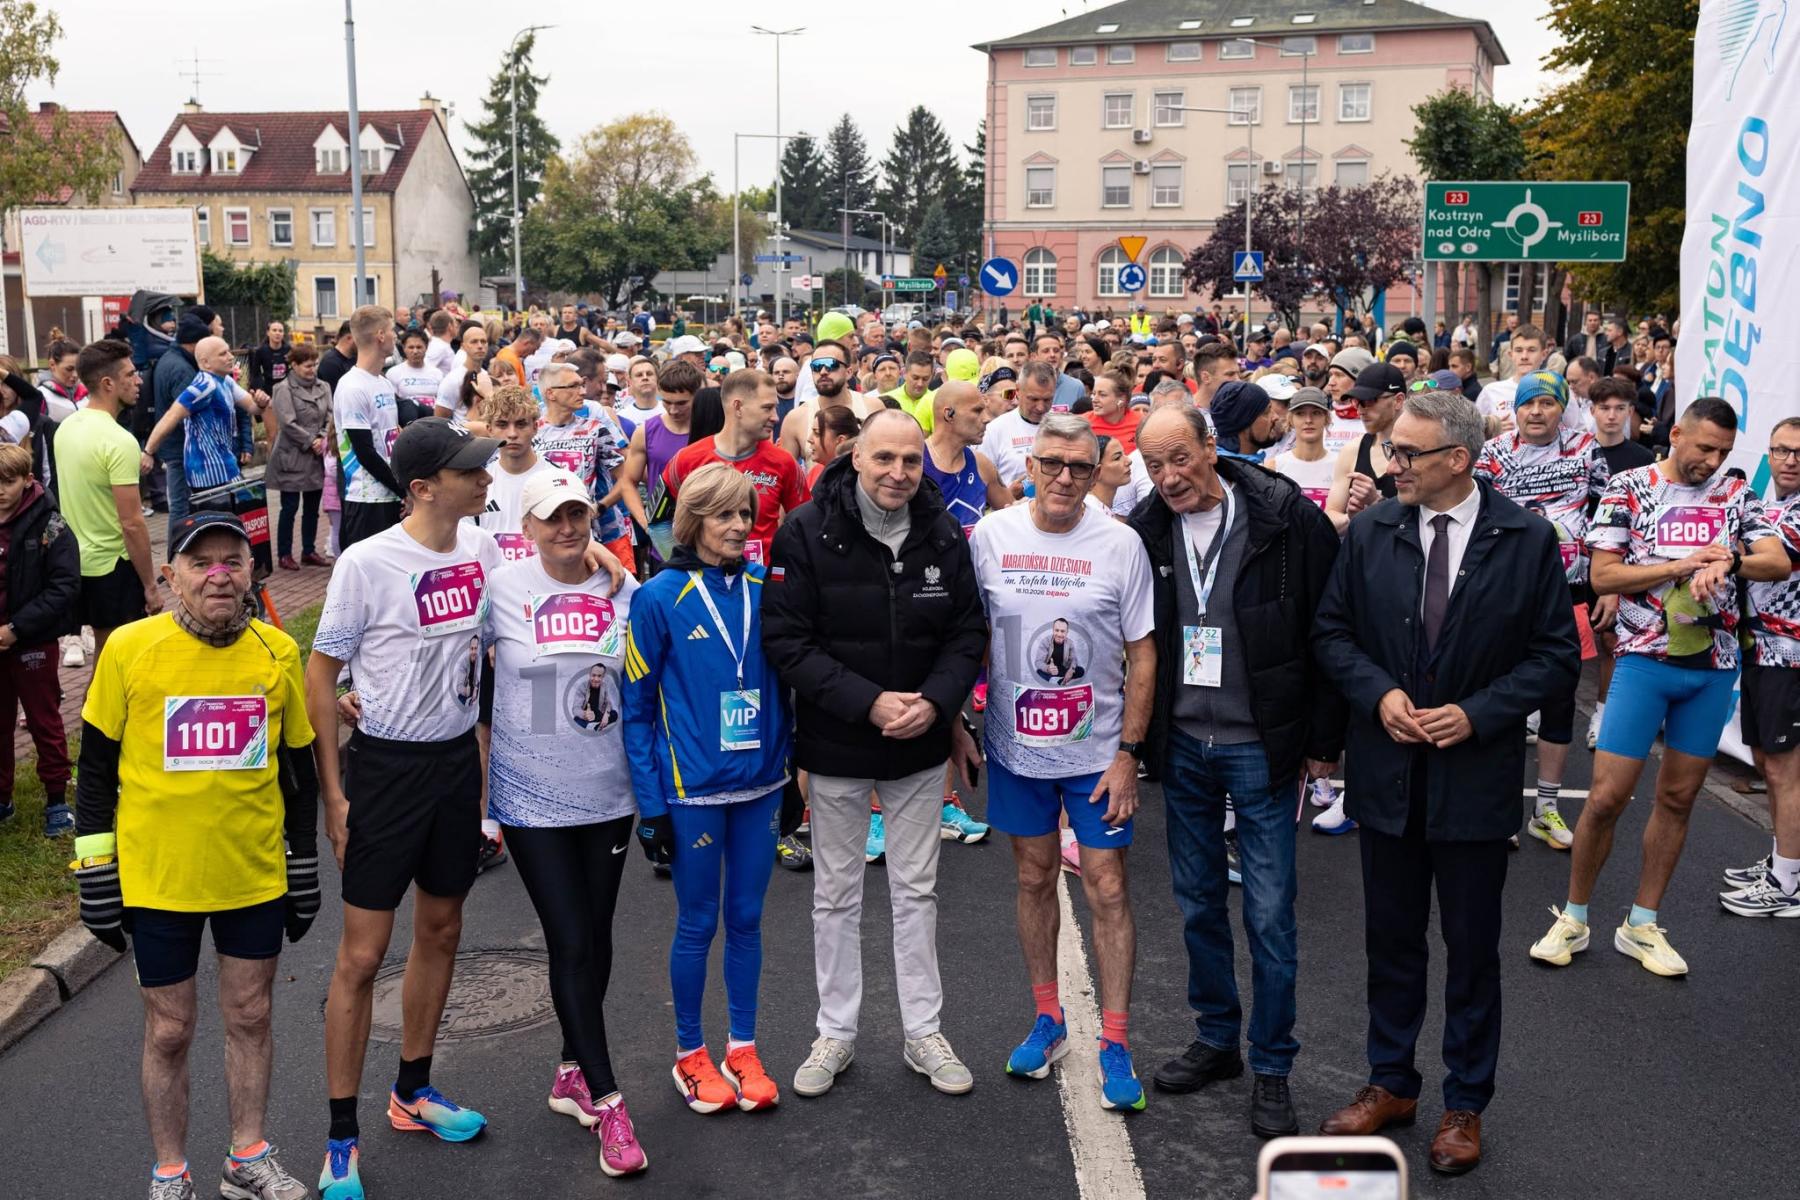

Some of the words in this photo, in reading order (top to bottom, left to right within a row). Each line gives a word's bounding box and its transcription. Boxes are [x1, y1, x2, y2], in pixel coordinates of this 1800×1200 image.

[1450, 193, 1464, 203] 23
[1428, 209, 1483, 224] Kostrzyn
[1583, 214, 1597, 224] 23
[1428, 227, 1453, 238] nad
[1458, 226, 1491, 240] Odrą
[1557, 229, 1620, 244] Myślibórz
[1720, 116, 1769, 433] DĘBNO
[1697, 213, 1731, 400] RATON
[243, 516, 268, 533] TASPORT
[1660, 522, 1710, 543] 1208
[500, 547, 527, 561] 93
[1002, 552, 1049, 570] MARATOŃSKA
[1050, 556, 1092, 576] DZIESIĄTKA
[1004, 576, 1016, 585] im.
[1019, 575, 1048, 587] Rafała
[1051, 576, 1086, 589] Wójcika
[421, 585, 472, 618] 1001
[538, 612, 599, 637] 1002
[1205, 629, 1217, 638] 52
[722, 708, 757, 727] VIP
[1020, 706, 1069, 731] 1031
[178, 722, 236, 750] 1101
